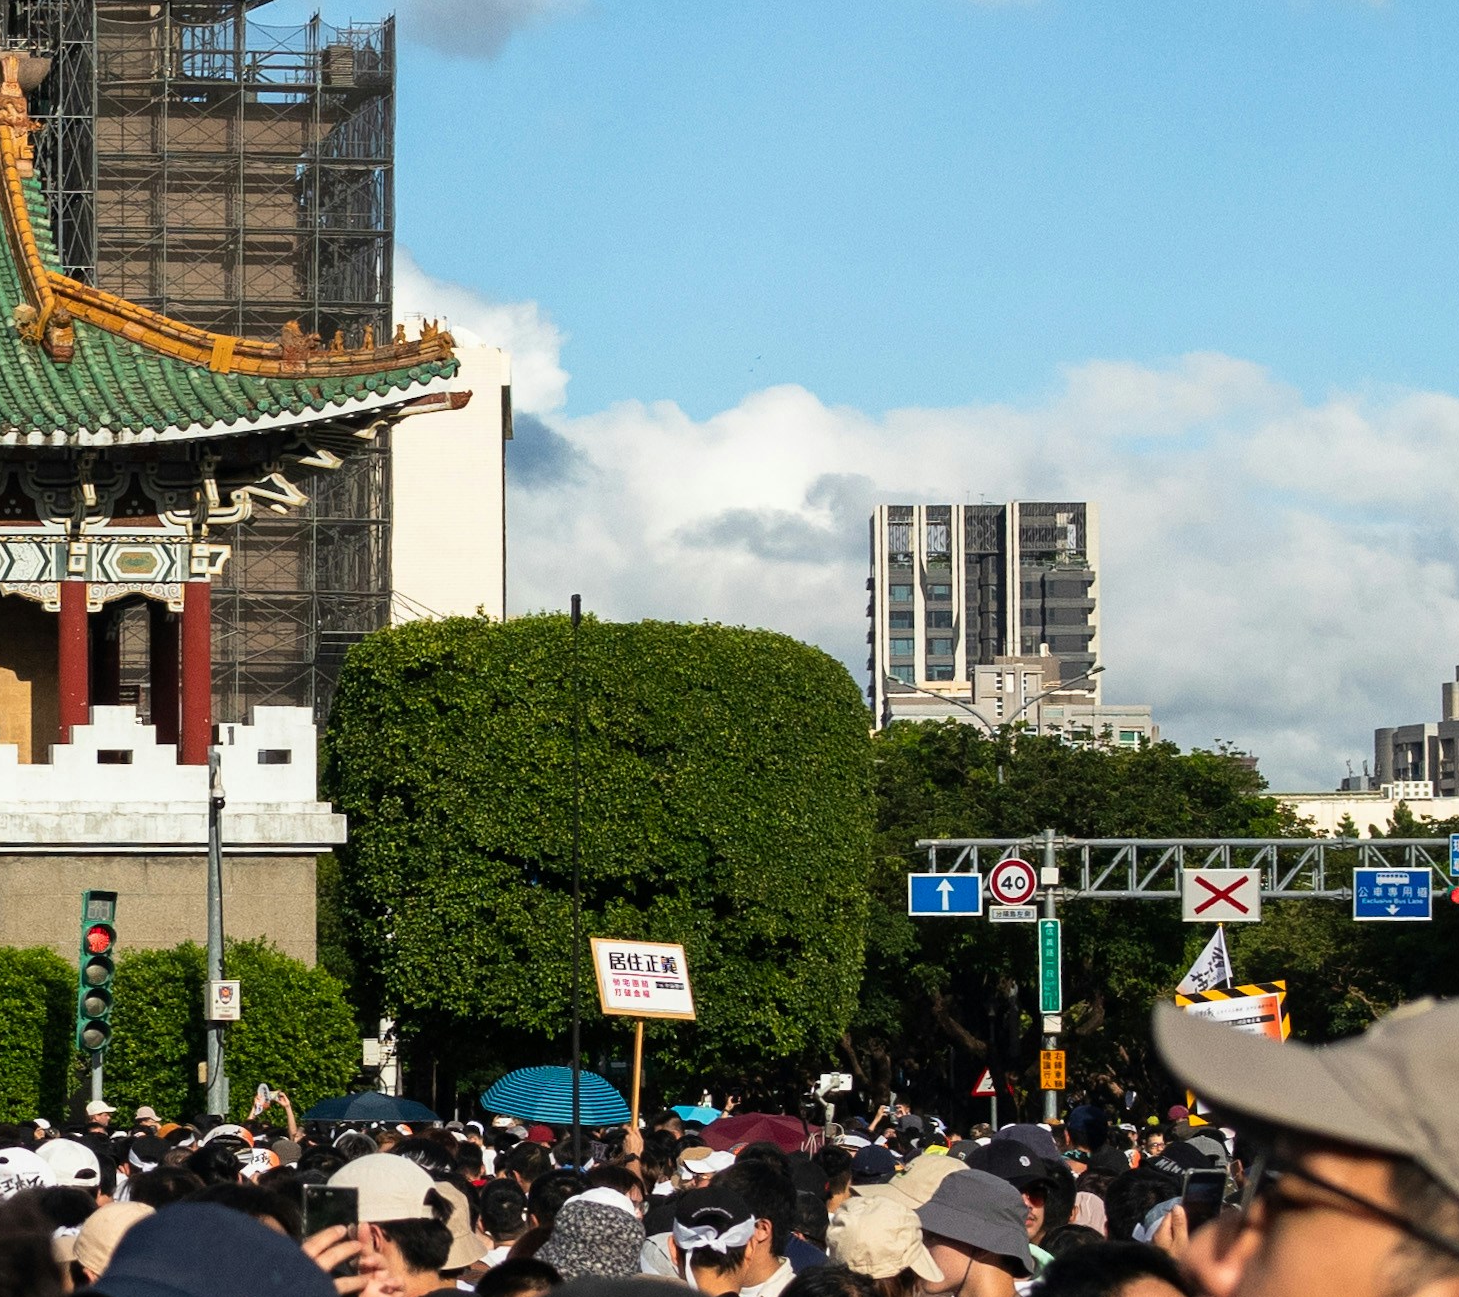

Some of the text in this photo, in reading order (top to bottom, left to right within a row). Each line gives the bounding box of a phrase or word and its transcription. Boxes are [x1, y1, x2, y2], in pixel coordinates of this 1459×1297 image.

[1001, 876, 1026, 891] 40
[1358, 886, 1428, 898] 公車專用道
[1045, 928, 1054, 978] 信義路一段
[608, 951, 678, 975] 居住正義
